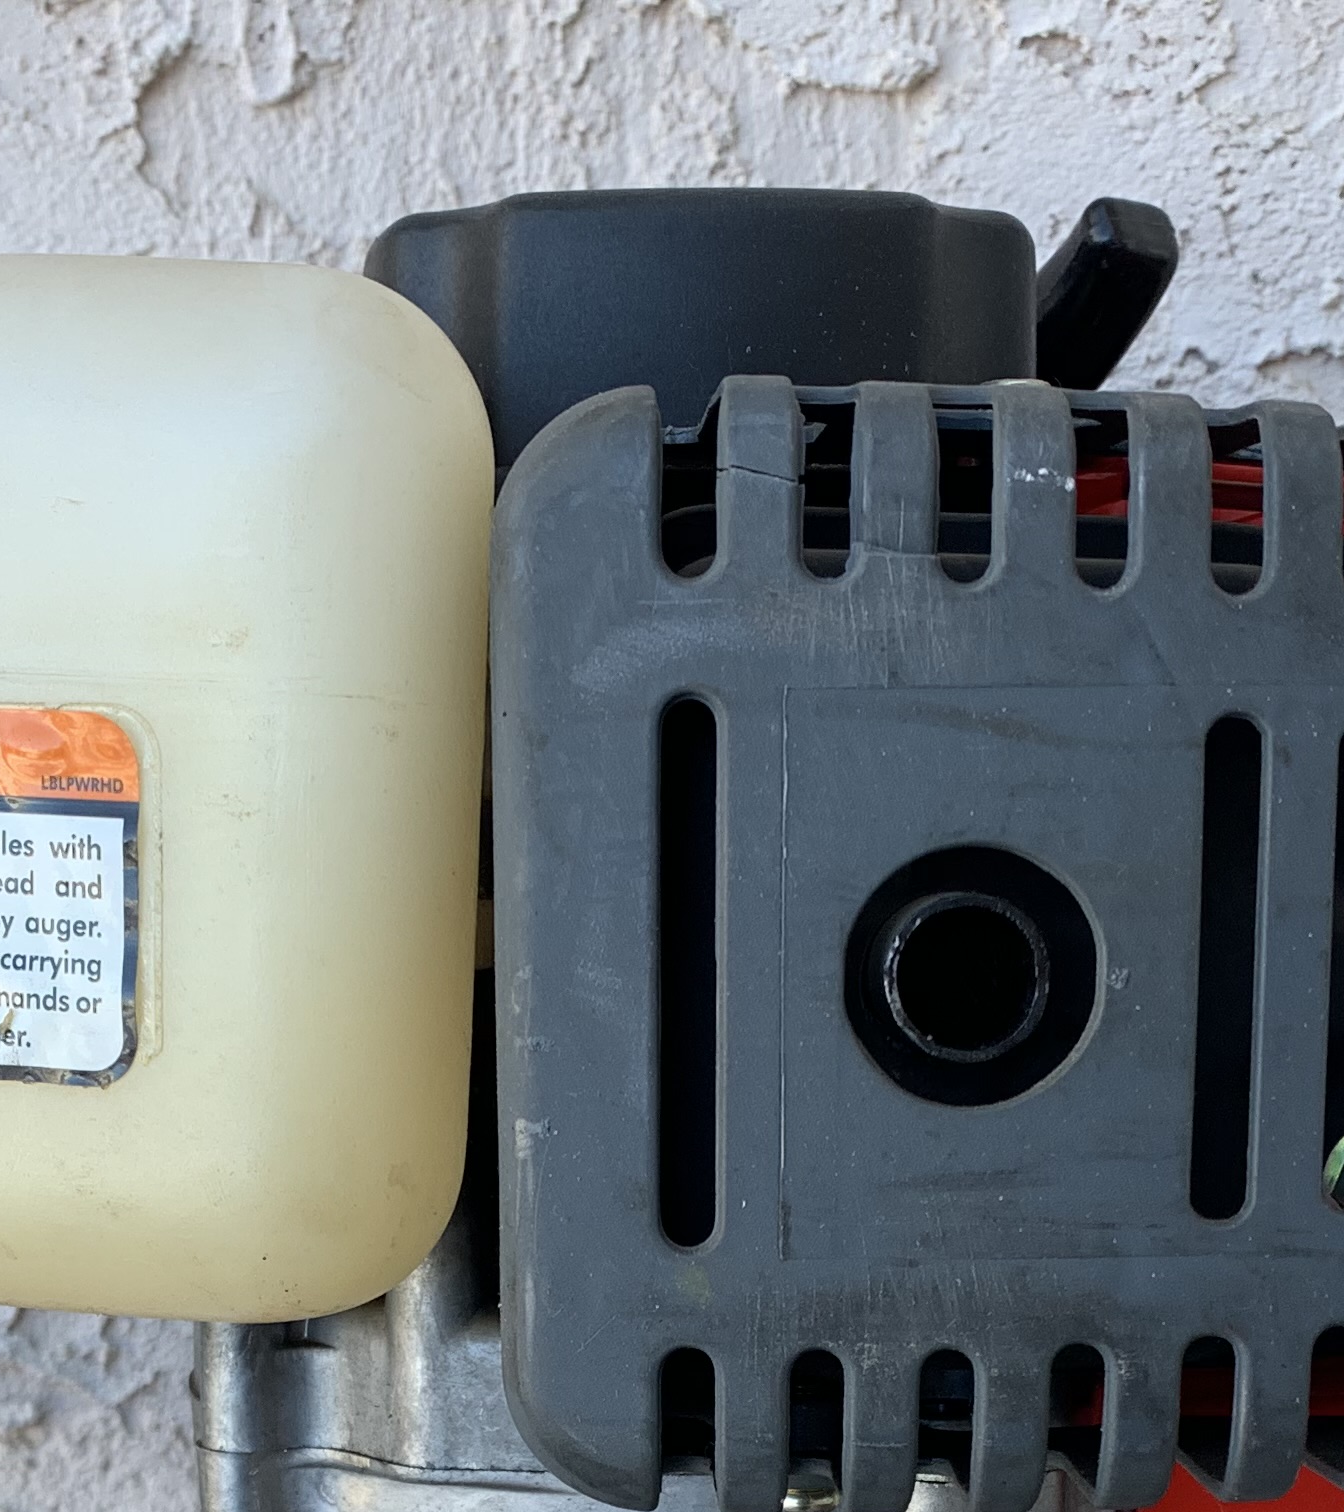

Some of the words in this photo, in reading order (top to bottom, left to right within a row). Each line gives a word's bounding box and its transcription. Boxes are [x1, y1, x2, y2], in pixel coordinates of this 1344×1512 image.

[41, 775, 124, 794] LBLPWRHD
[50, 834, 102, 861] with
[55, 875, 102, 900] and
[25, 915, 102, 942] auger.
[0, 954, 102, 983] carrying
[76, 996, 102, 1013] or
